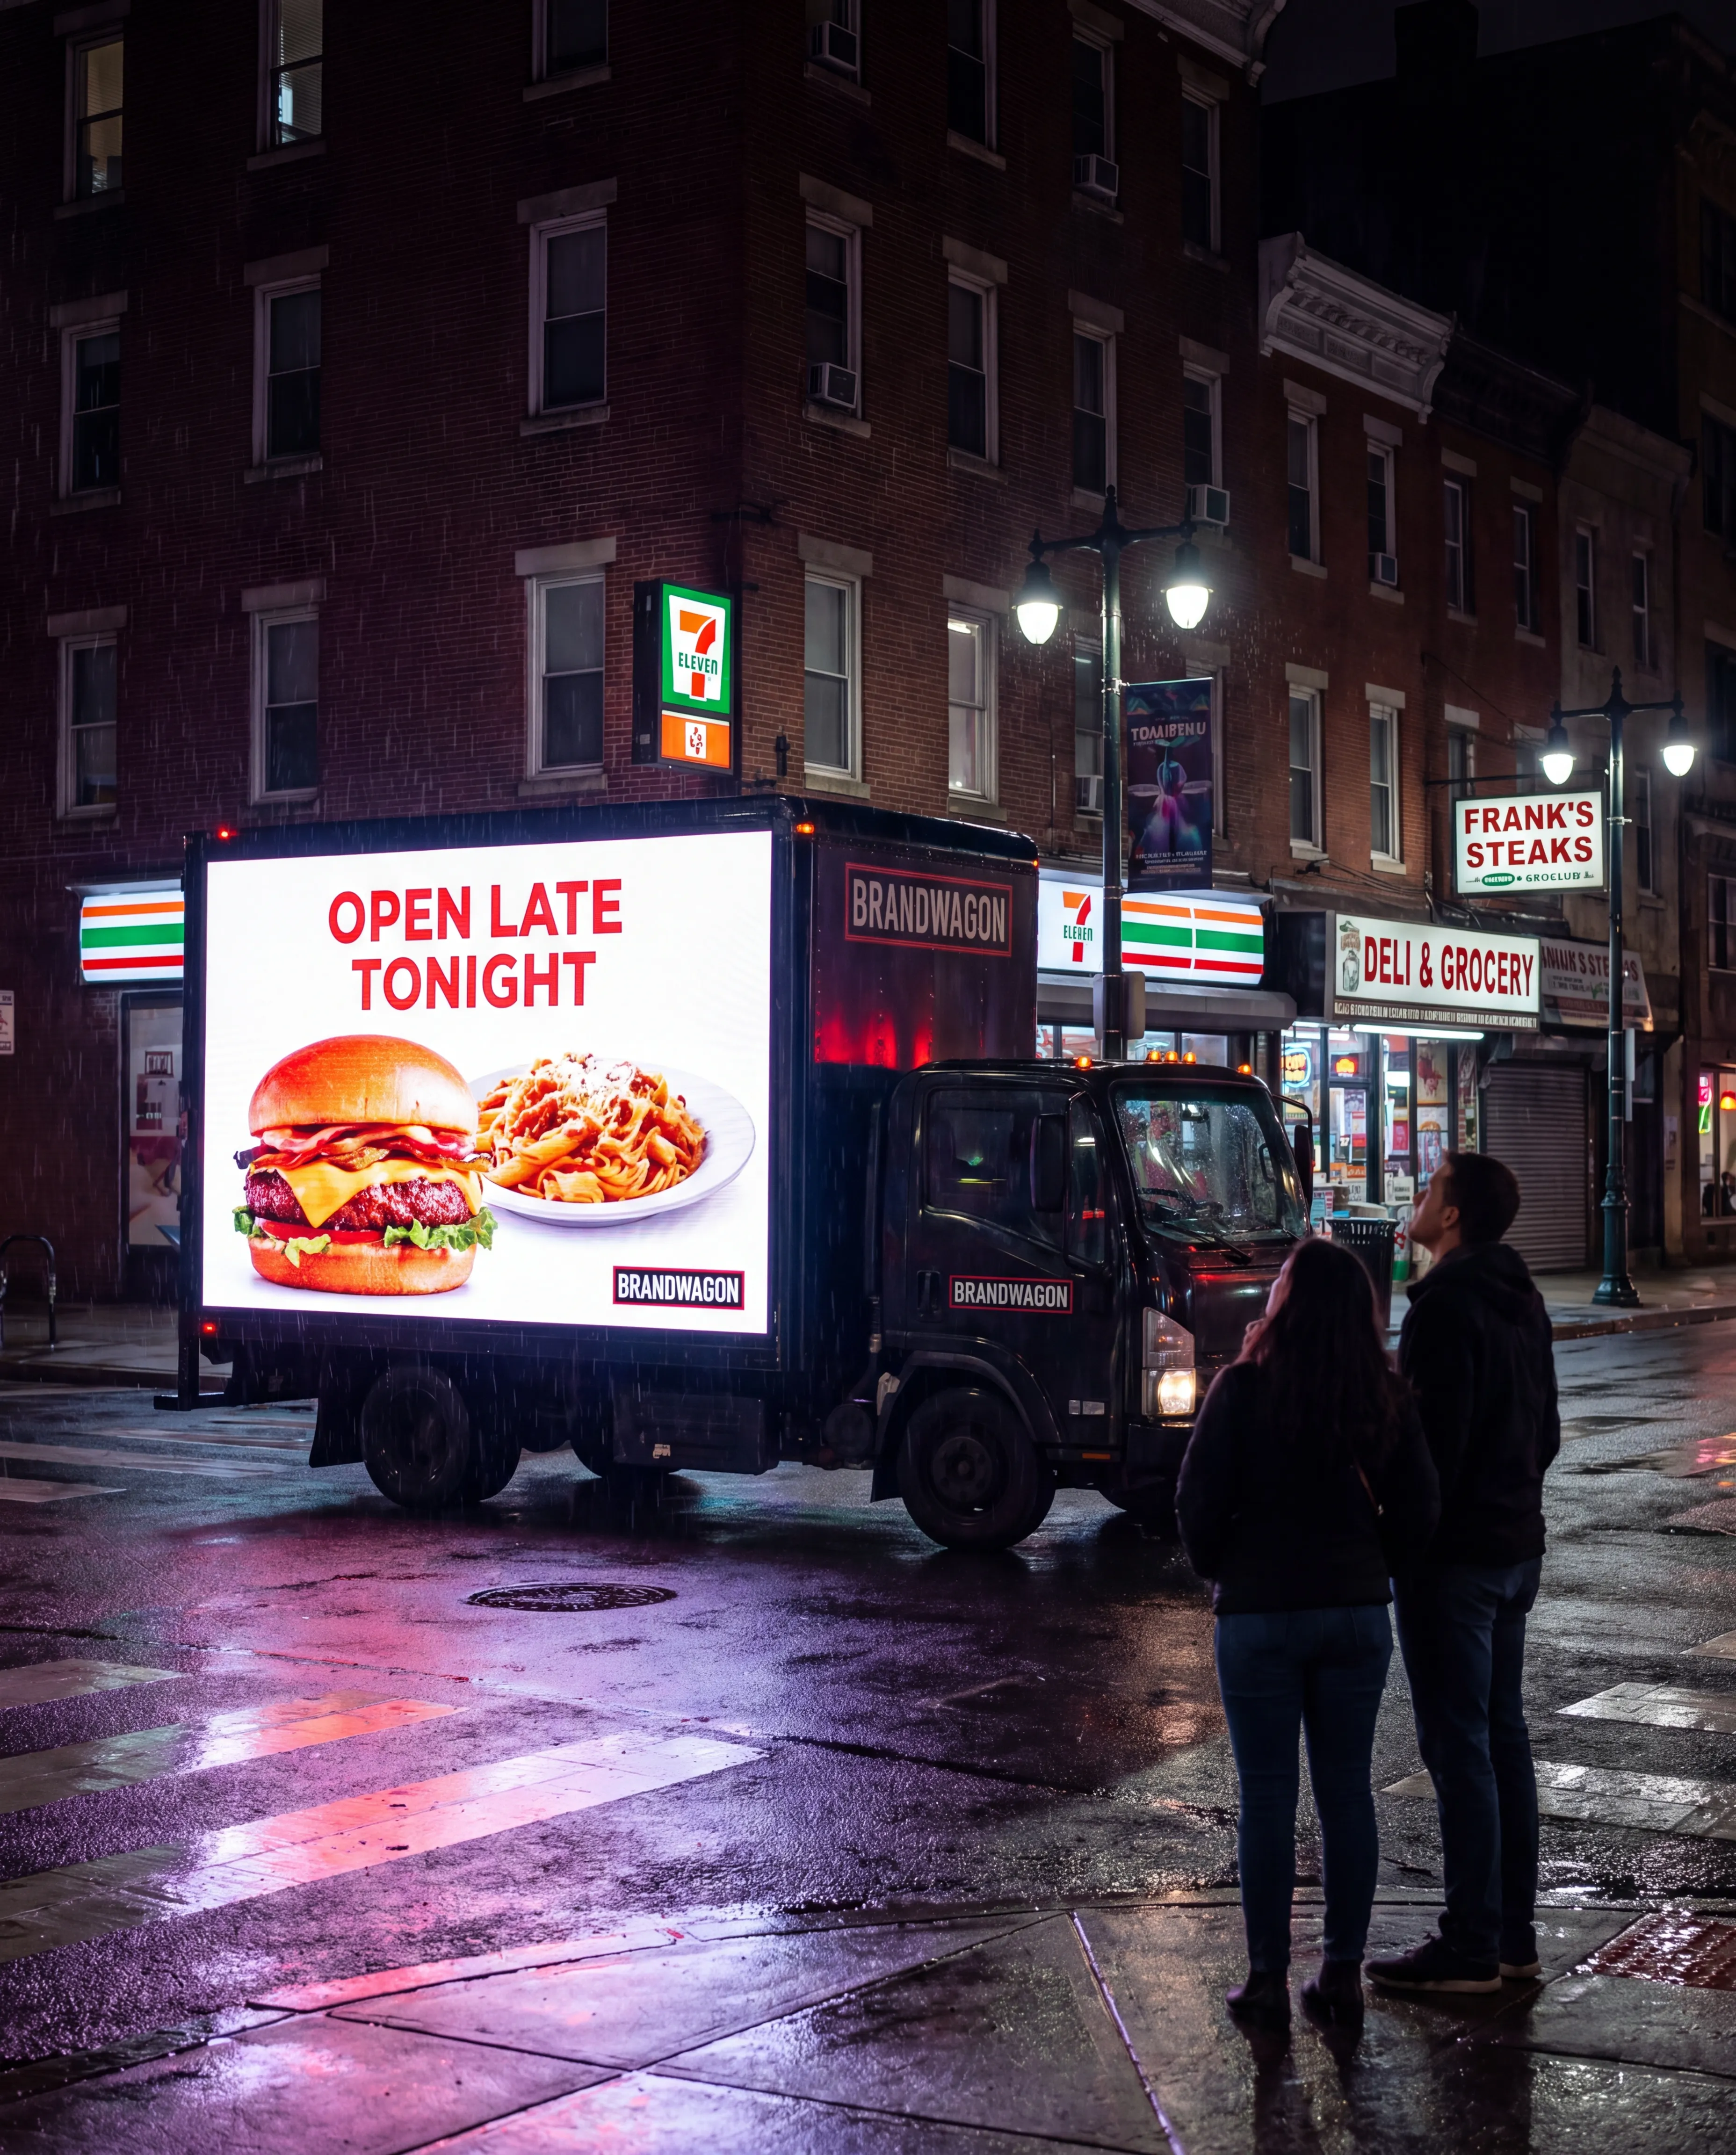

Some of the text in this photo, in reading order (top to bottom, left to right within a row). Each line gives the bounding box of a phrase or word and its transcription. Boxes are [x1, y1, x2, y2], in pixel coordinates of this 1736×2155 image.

[680, 610, 716, 698] 7
[1465, 801, 1594, 834] FRANK'S
[1467, 836, 1592, 868] STEAKS
[328, 878, 622, 944] OPEN LATE
[853, 878, 1005, 943] BRANDWAGON
[1063, 891, 1091, 962] 7
[352, 951, 596, 1011] TONIGHT
[1364, 936, 1533, 997] DELI & GROCERY
[618, 1273, 738, 1303] BRANDWAGON
[954, 1281, 1068, 1308] BRANDWAGON
